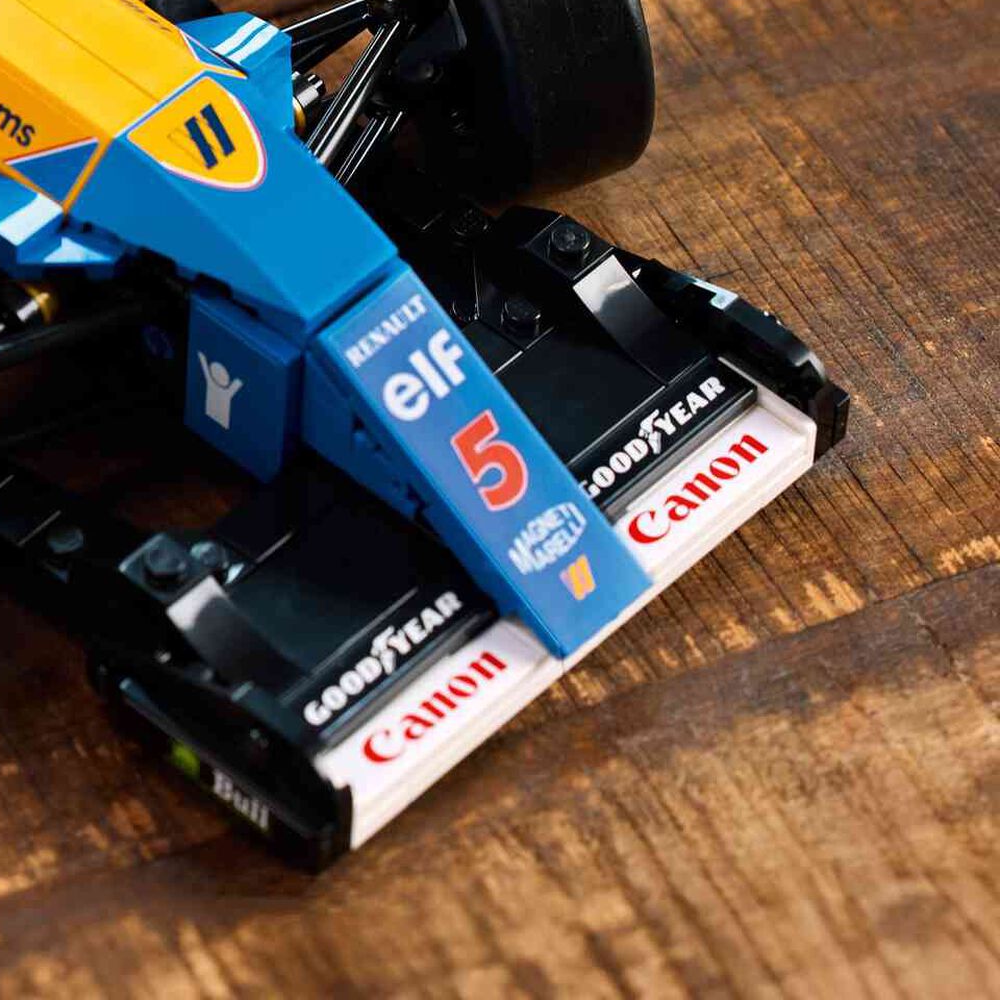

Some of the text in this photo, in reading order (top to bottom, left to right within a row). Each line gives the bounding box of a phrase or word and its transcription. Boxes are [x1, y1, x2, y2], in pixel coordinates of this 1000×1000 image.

[344, 294, 427, 369] RENAULT
[382, 327, 466, 422] elf
[450, 409, 529, 512] 5
[628, 434, 769, 544] Canon
[303, 591, 463, 727] GOODYEAR
[362, 651, 508, 764] Canon
